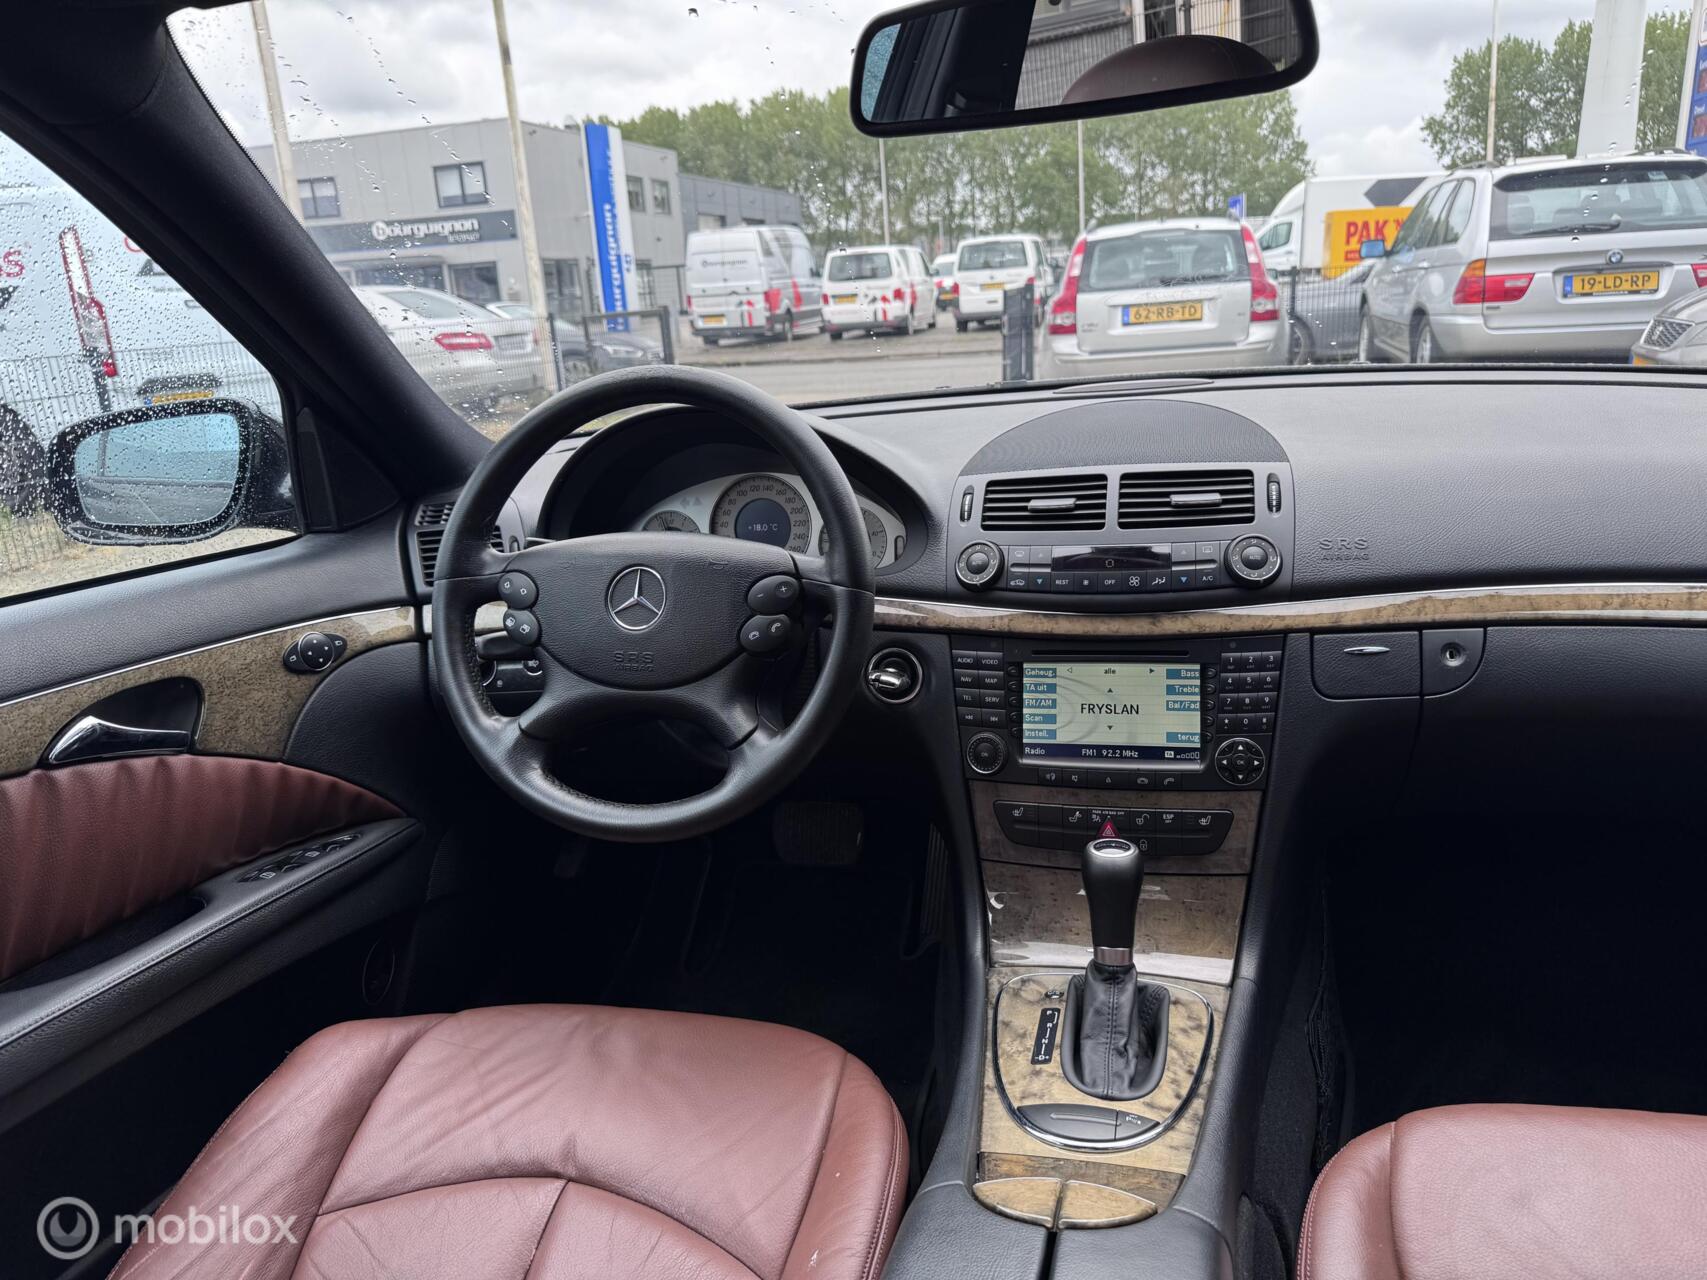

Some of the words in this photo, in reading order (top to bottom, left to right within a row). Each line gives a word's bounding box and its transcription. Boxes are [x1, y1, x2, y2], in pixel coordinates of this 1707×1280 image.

[1345, 220, 1388, 246] PAK
[1580, 274, 1651, 290] 19-LD-RP
[1133, 305, 1197, 321] 62-RB-TD
[1319, 537, 1368, 550] SRS
[1025, 668, 1055, 677] Geheug.
[1181, 669, 1200, 677] Bass
[1174, 685, 1200, 693] Treble
[1080, 703, 1140, 715] FRYSLAN
[1168, 701, 1200, 709] Bal/Fad
[1025, 714, 1043, 722] Scan
[1177, 733, 1200, 743] terug
[1024, 747, 1045, 755] Radio
[1081, 749, 1097, 757] FM1
[1102, 749, 1120, 757] 92.2
[1122, 750, 1139, 758] MHz
